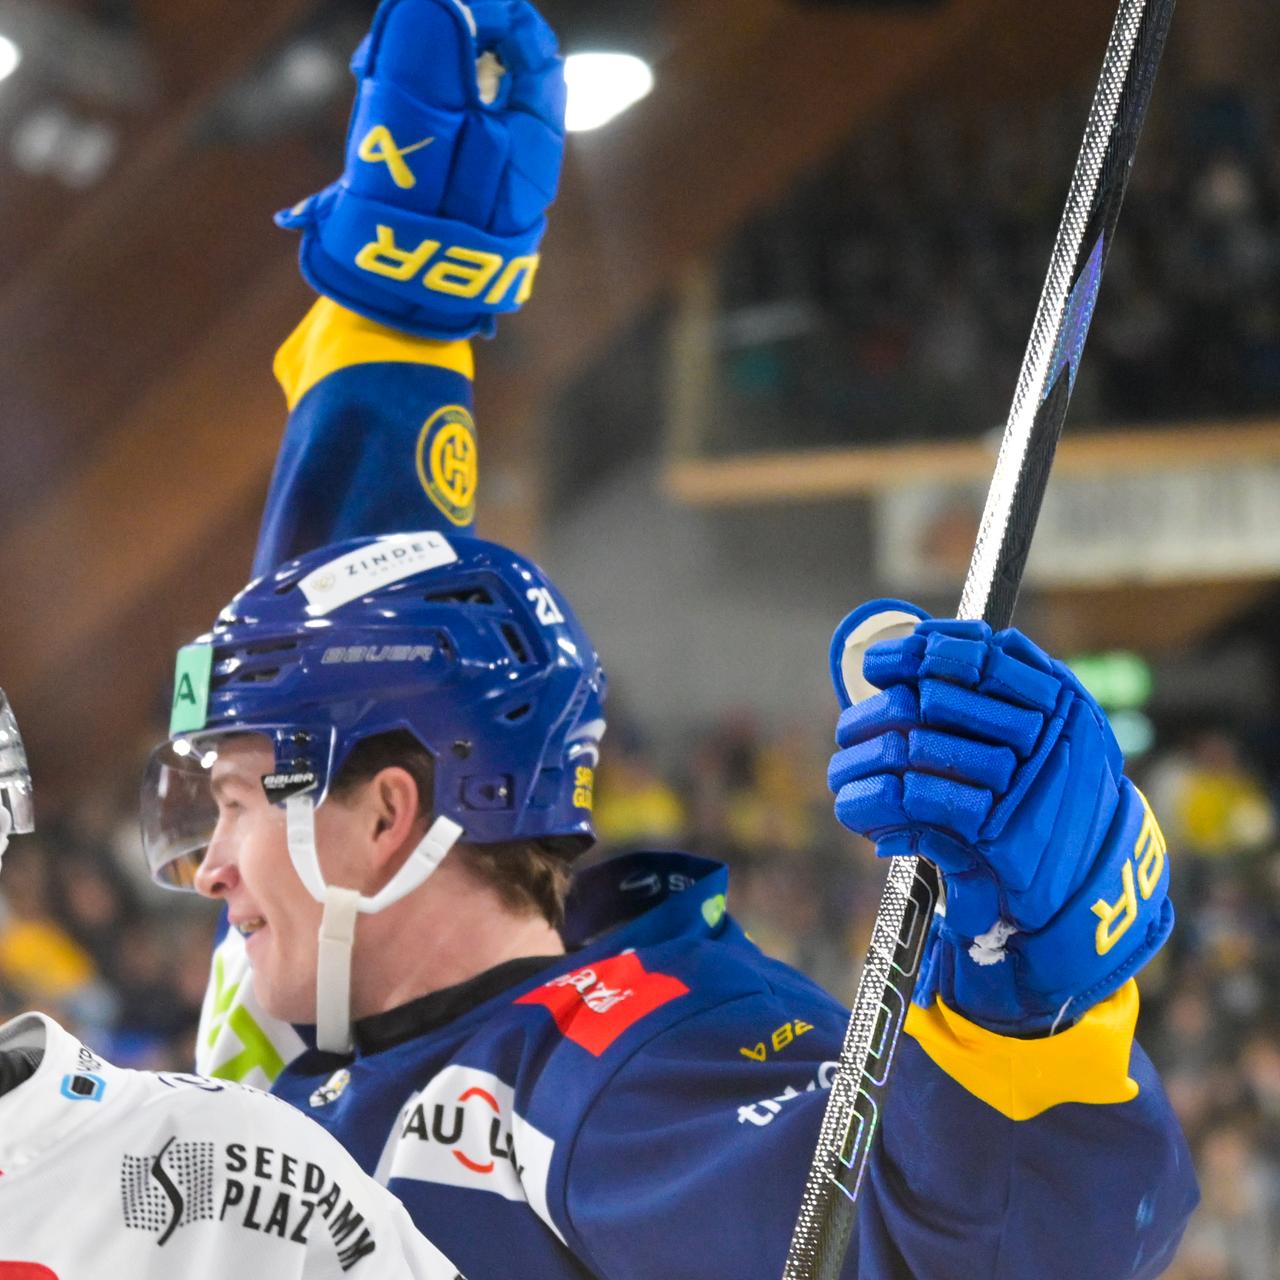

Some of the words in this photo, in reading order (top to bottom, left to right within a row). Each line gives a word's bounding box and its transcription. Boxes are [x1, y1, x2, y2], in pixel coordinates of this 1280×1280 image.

[345, 540, 440, 576] ZINDEL
[526, 586, 565, 625] 21
[173, 671, 197, 708] A
